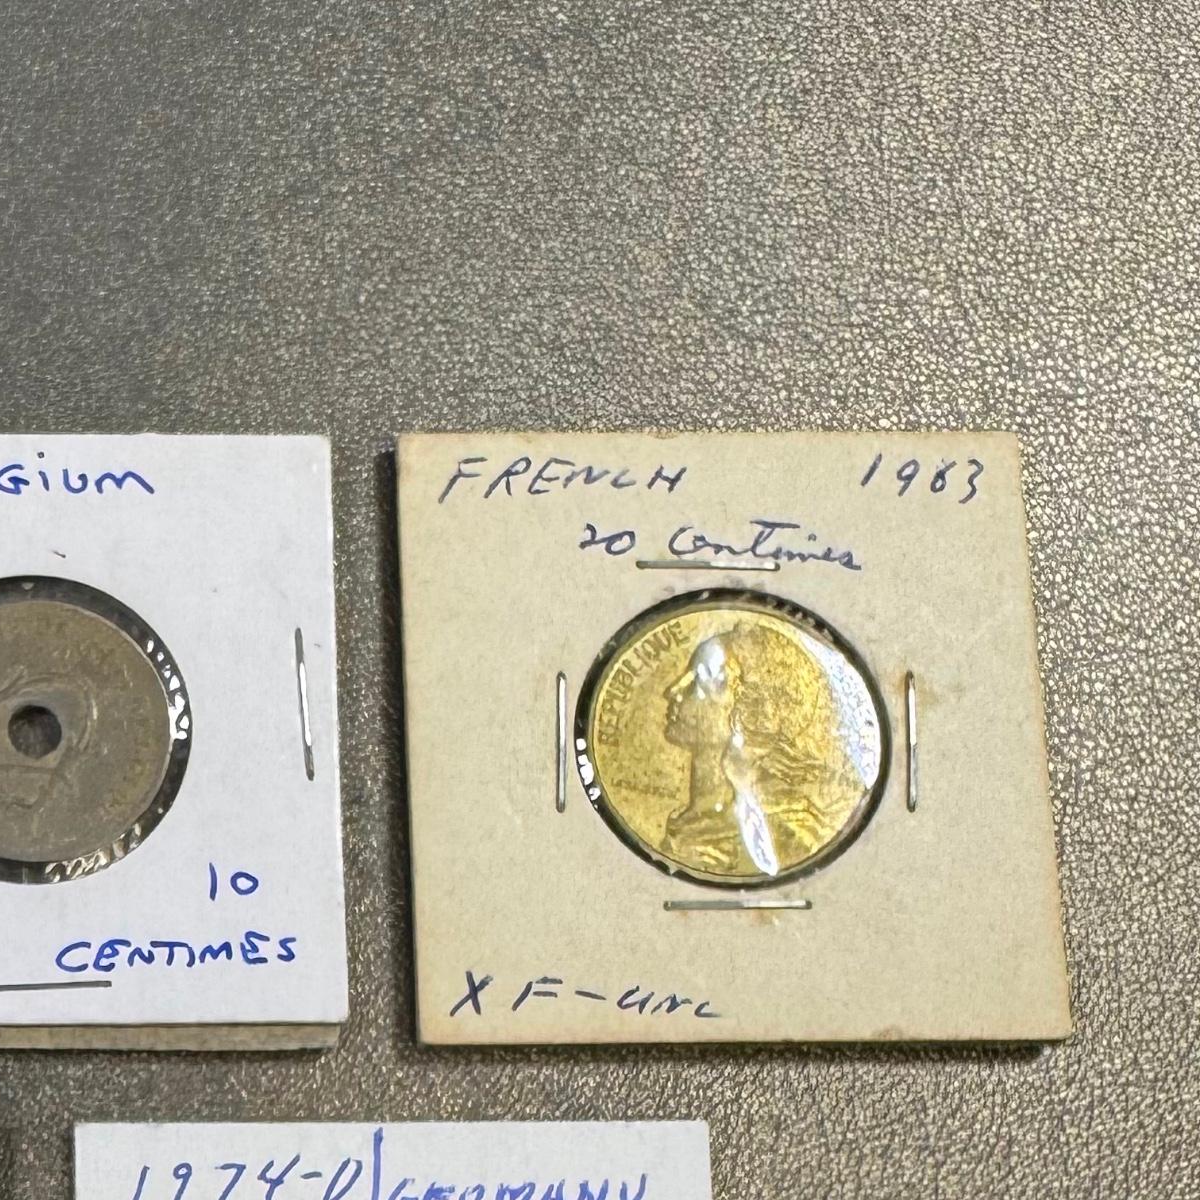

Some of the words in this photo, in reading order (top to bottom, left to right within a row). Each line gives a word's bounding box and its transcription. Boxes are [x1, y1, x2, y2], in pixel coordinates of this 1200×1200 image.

[438, 456, 688, 504] FRENCH
[578, 523, 636, 556] 20
[208, 862, 260, 902] 10
[55, 931, 298, 974] CENTIMES
